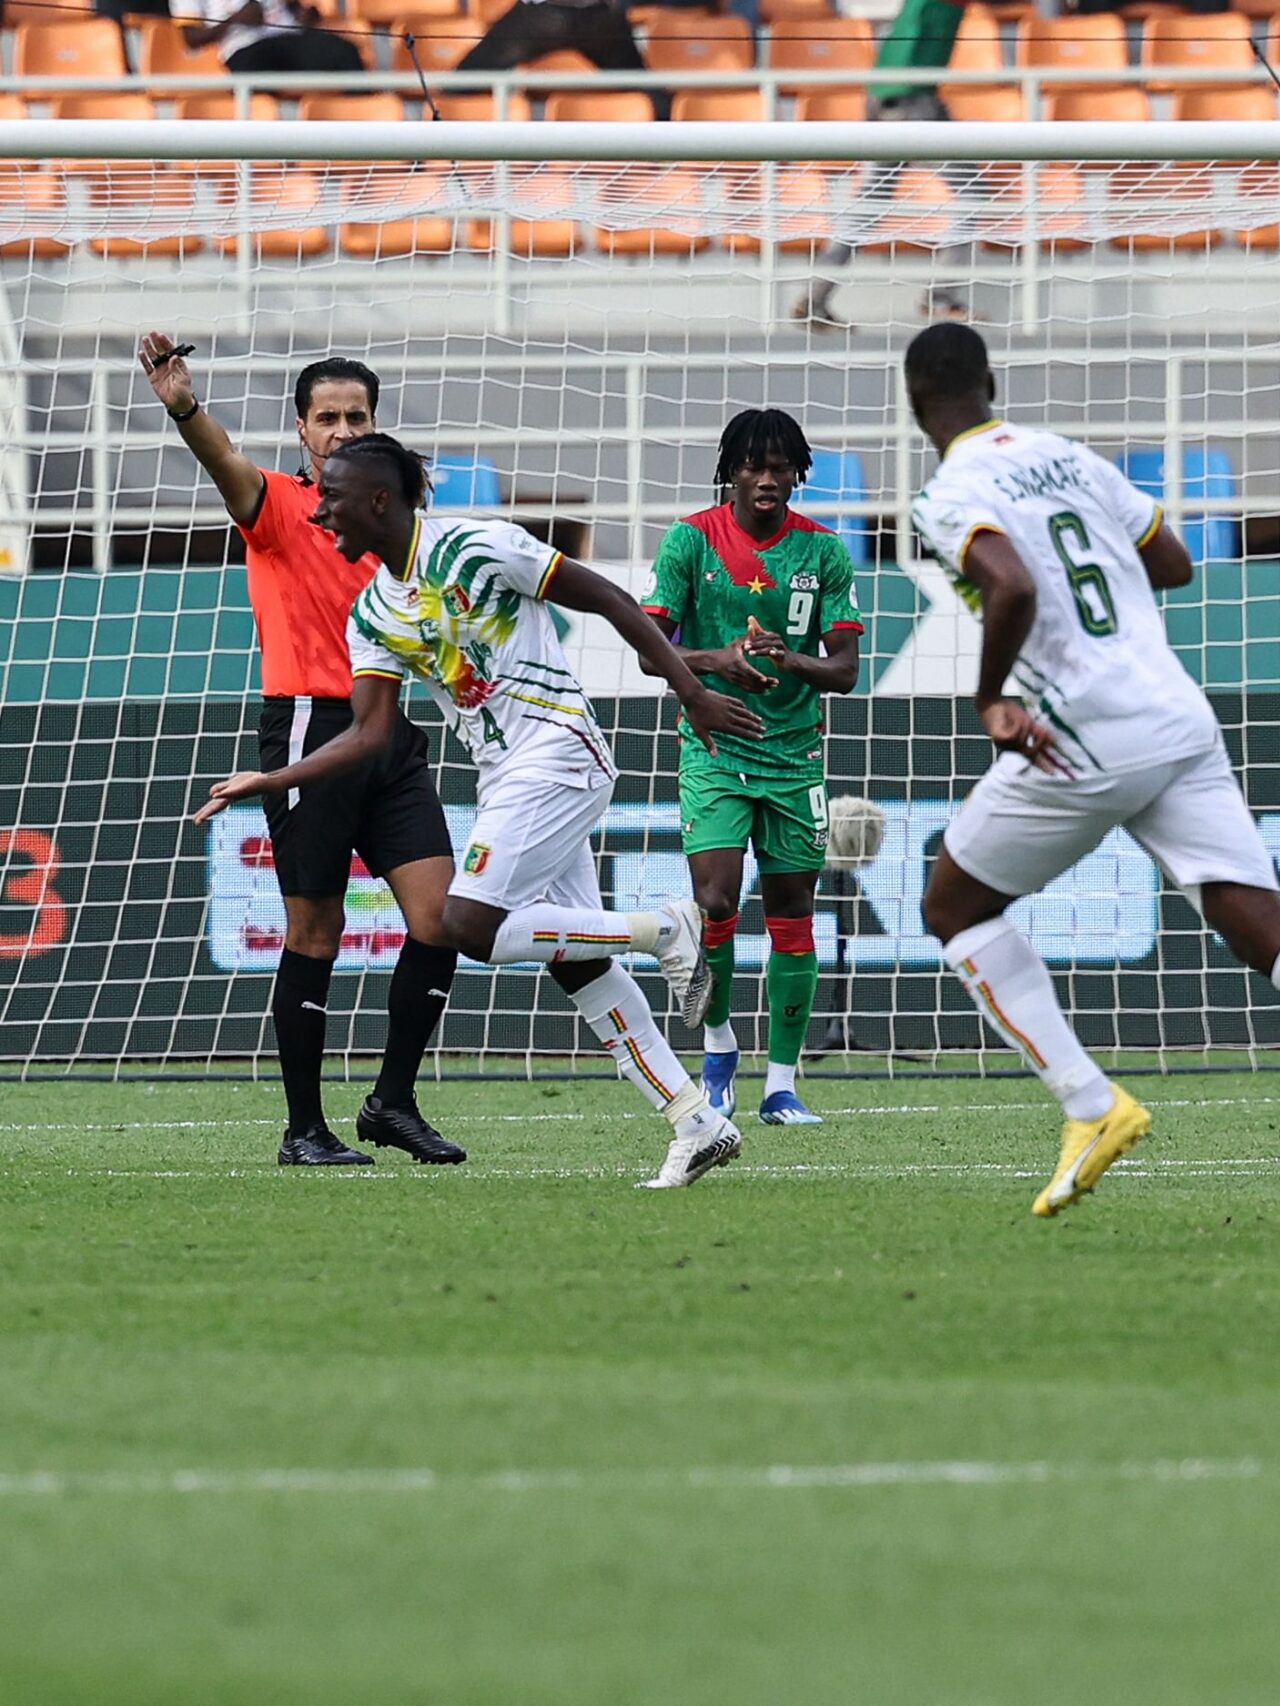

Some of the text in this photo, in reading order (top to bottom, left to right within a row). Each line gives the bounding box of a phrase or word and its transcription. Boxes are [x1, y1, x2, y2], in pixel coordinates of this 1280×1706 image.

[1048, 510, 1118, 638] 6
[786, 591, 814, 636] 9
[481, 706, 509, 750] 4
[808, 784, 830, 831] 9
[0, 829, 69, 960] 3
